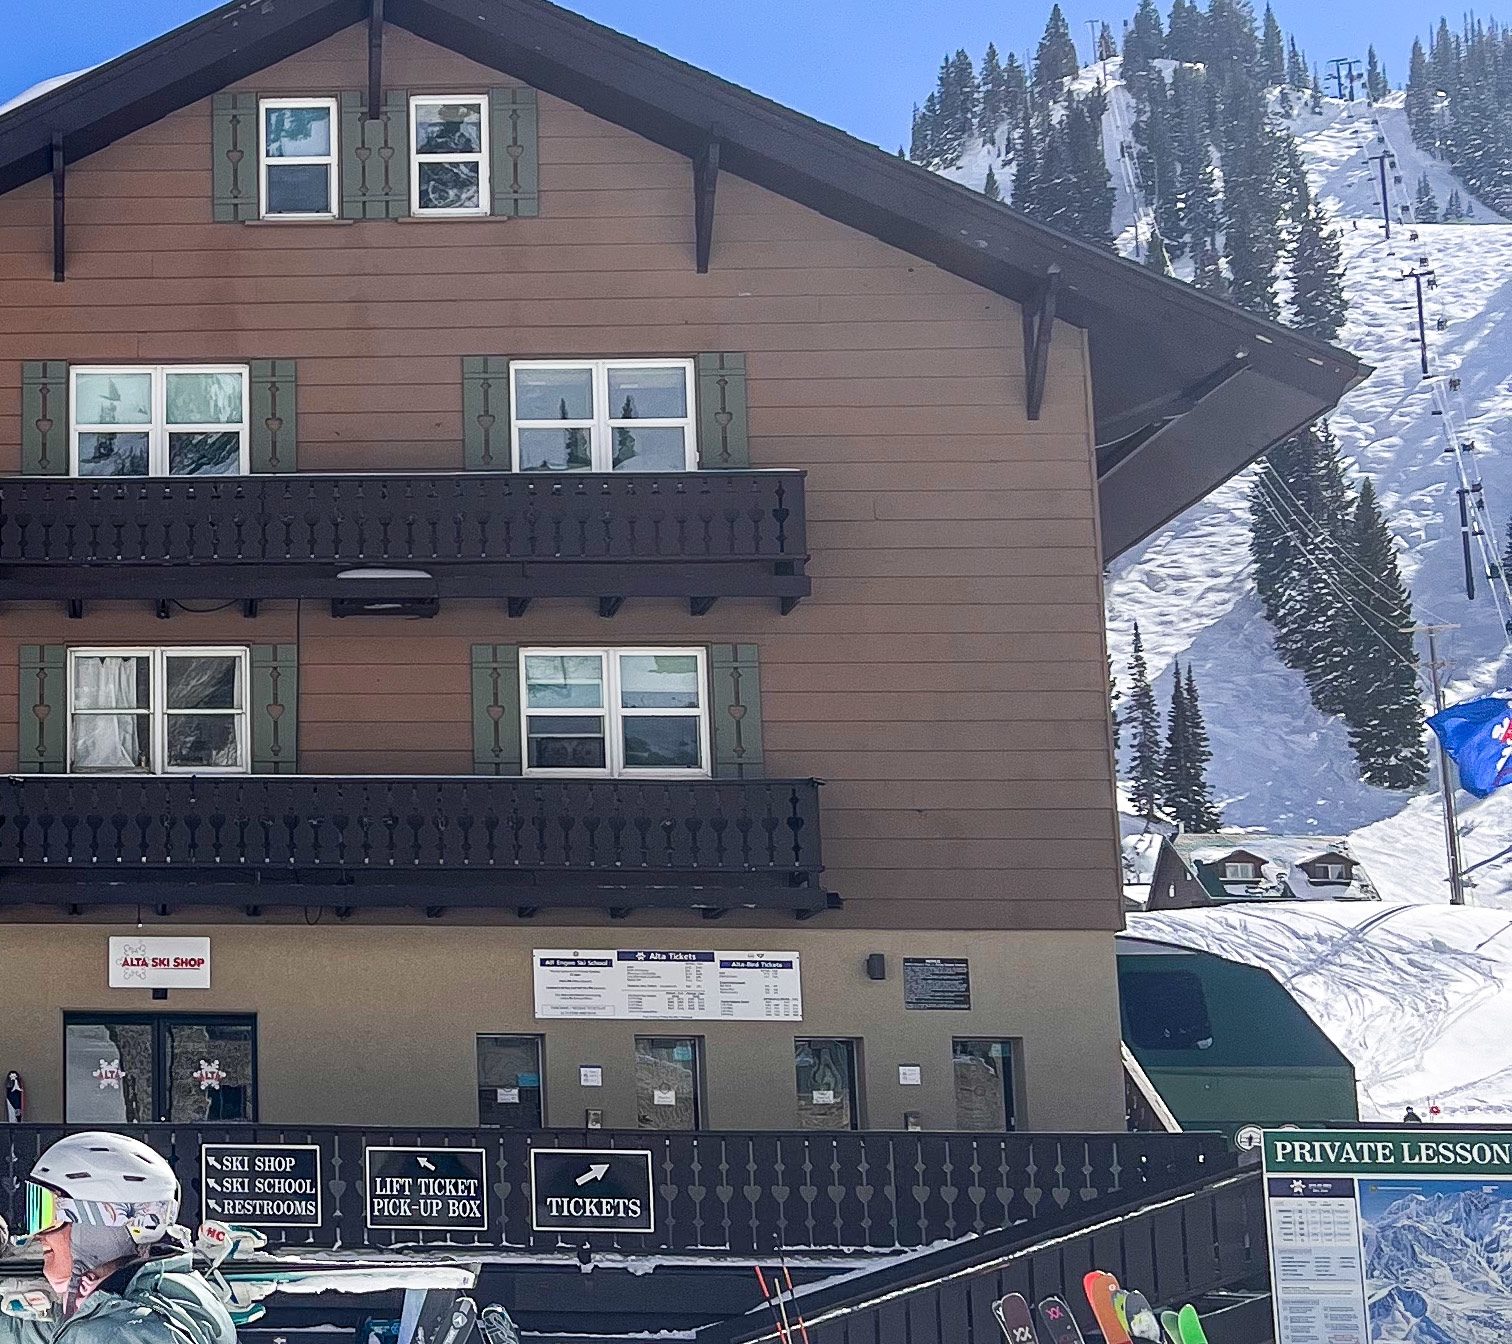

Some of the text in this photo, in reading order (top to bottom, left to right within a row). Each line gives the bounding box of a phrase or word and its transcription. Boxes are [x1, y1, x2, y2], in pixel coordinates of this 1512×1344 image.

[122, 957, 205, 968] ALTA SKI SHOP
[649, 952, 697, 960] Alta Tickets
[1274, 1140, 1511, 1165] PRIVATE LESSON
[222, 1155, 295, 1172] SKI SHOP
[222, 1177, 315, 1194] SKI SCHOOL
[374, 1177, 478, 1197] LIFT TICKET
[222, 1199, 316, 1216] RESTROOMS
[372, 1198, 481, 1218] PICK-UP BOX
[547, 1197, 641, 1218] TICKETS
